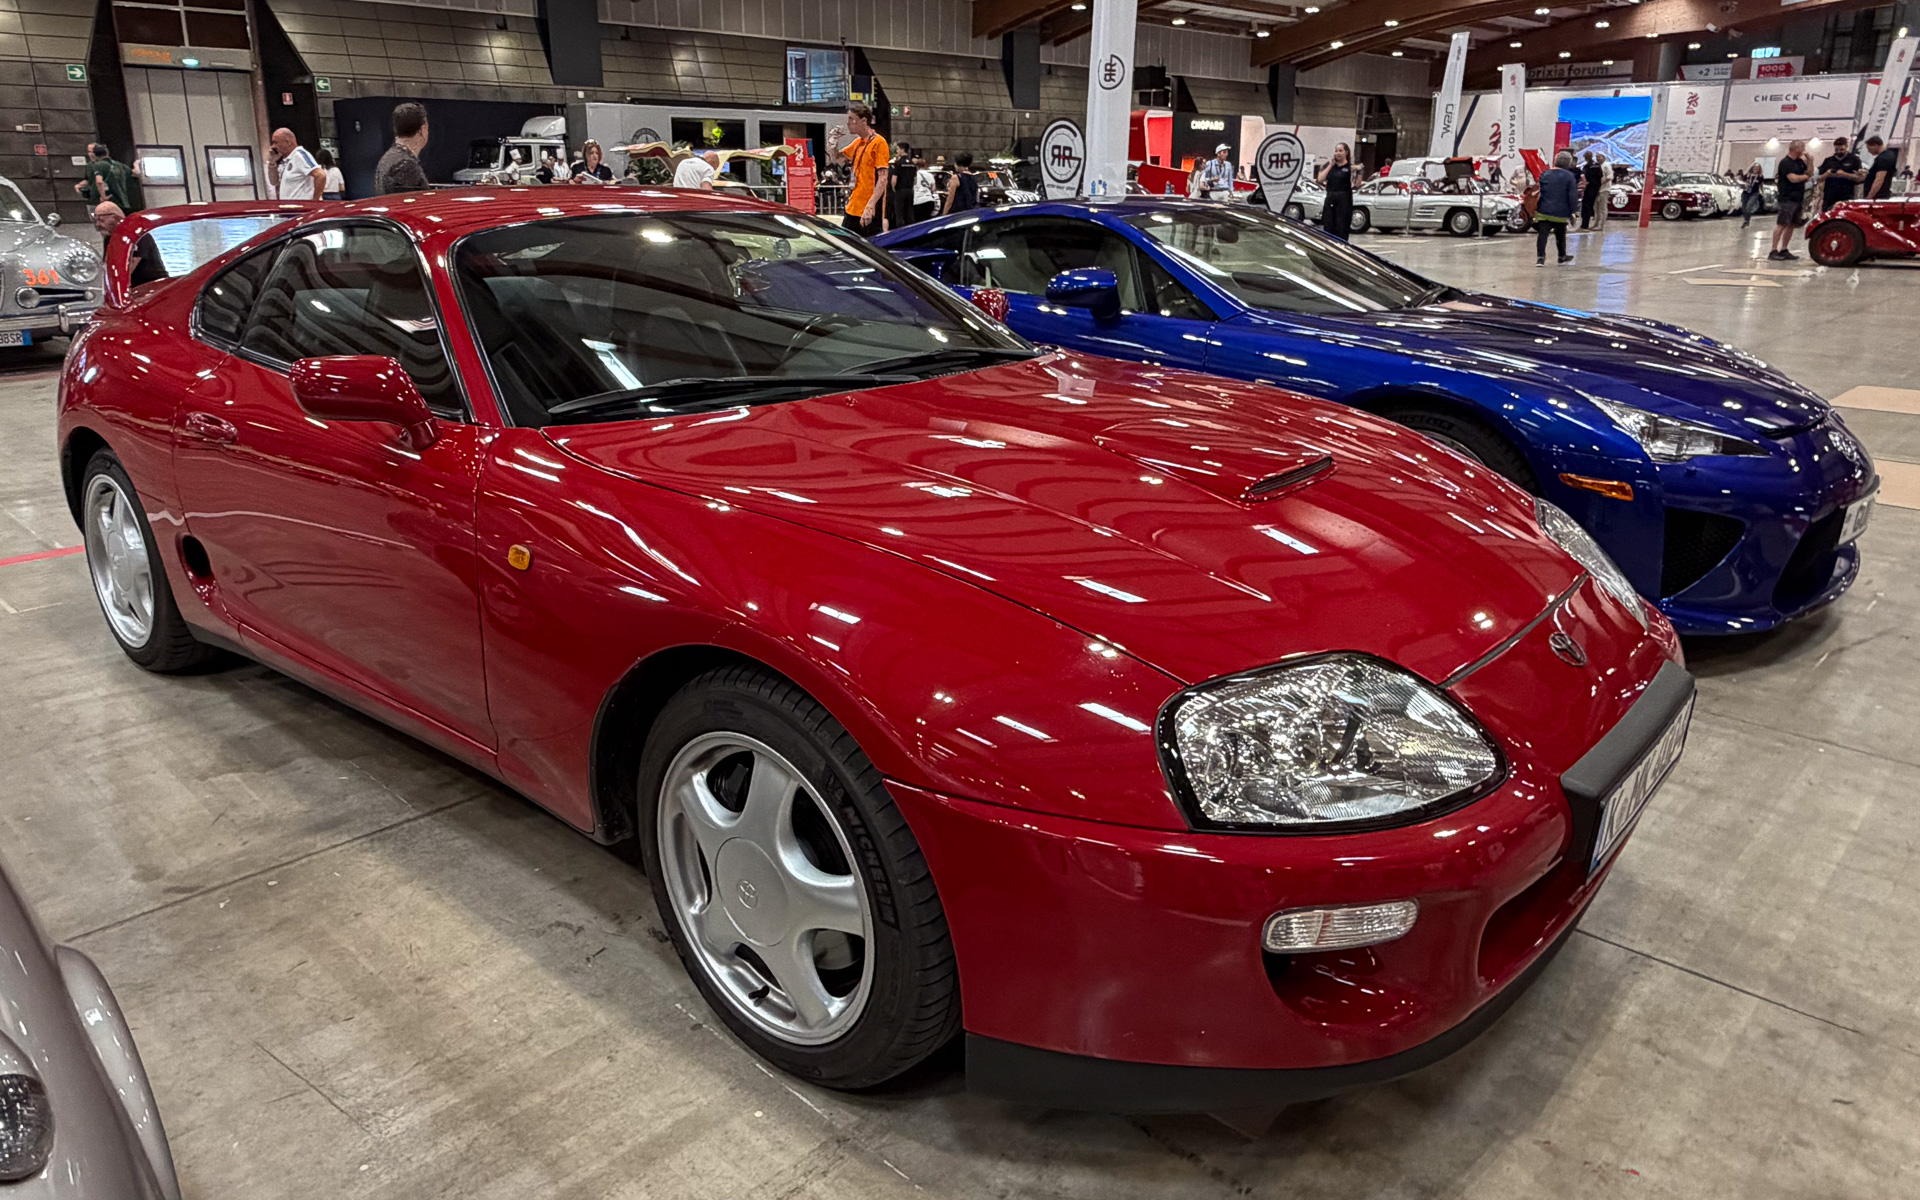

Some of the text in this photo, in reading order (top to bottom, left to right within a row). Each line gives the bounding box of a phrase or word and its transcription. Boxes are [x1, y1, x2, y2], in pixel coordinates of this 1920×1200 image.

[1566, 64, 1609, 76] forum
[1753, 92, 1830, 102] CHECK IN
[23, 269, 59, 286] 361
